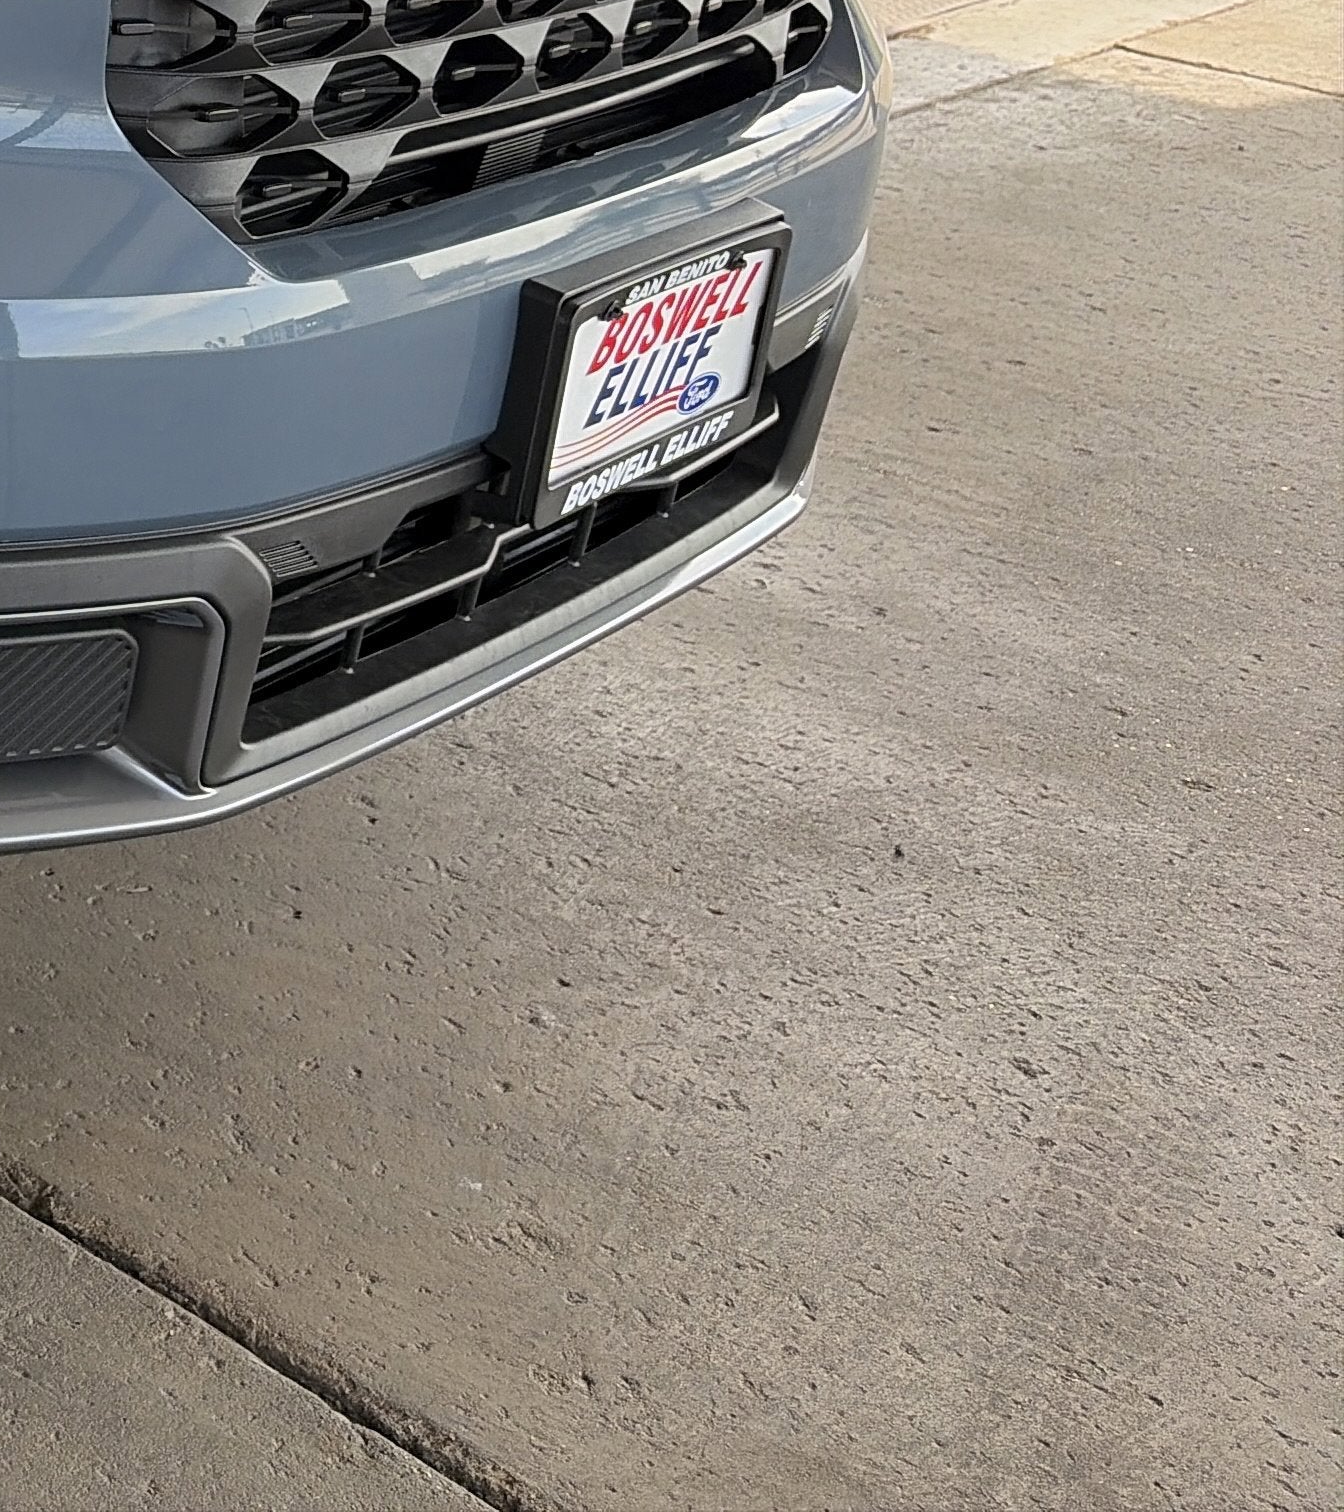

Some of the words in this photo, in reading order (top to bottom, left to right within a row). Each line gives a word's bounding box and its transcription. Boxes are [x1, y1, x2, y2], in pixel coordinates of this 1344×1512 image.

[586, 261, 763, 376] BOSWELL
[625, 273, 665, 305] SAN
[664, 250, 730, 290] BENITO
[583, 323, 722, 429] ELLIFF
[561, 448, 660, 516] BOSWELL
[661, 410, 734, 465] ELLIFF
